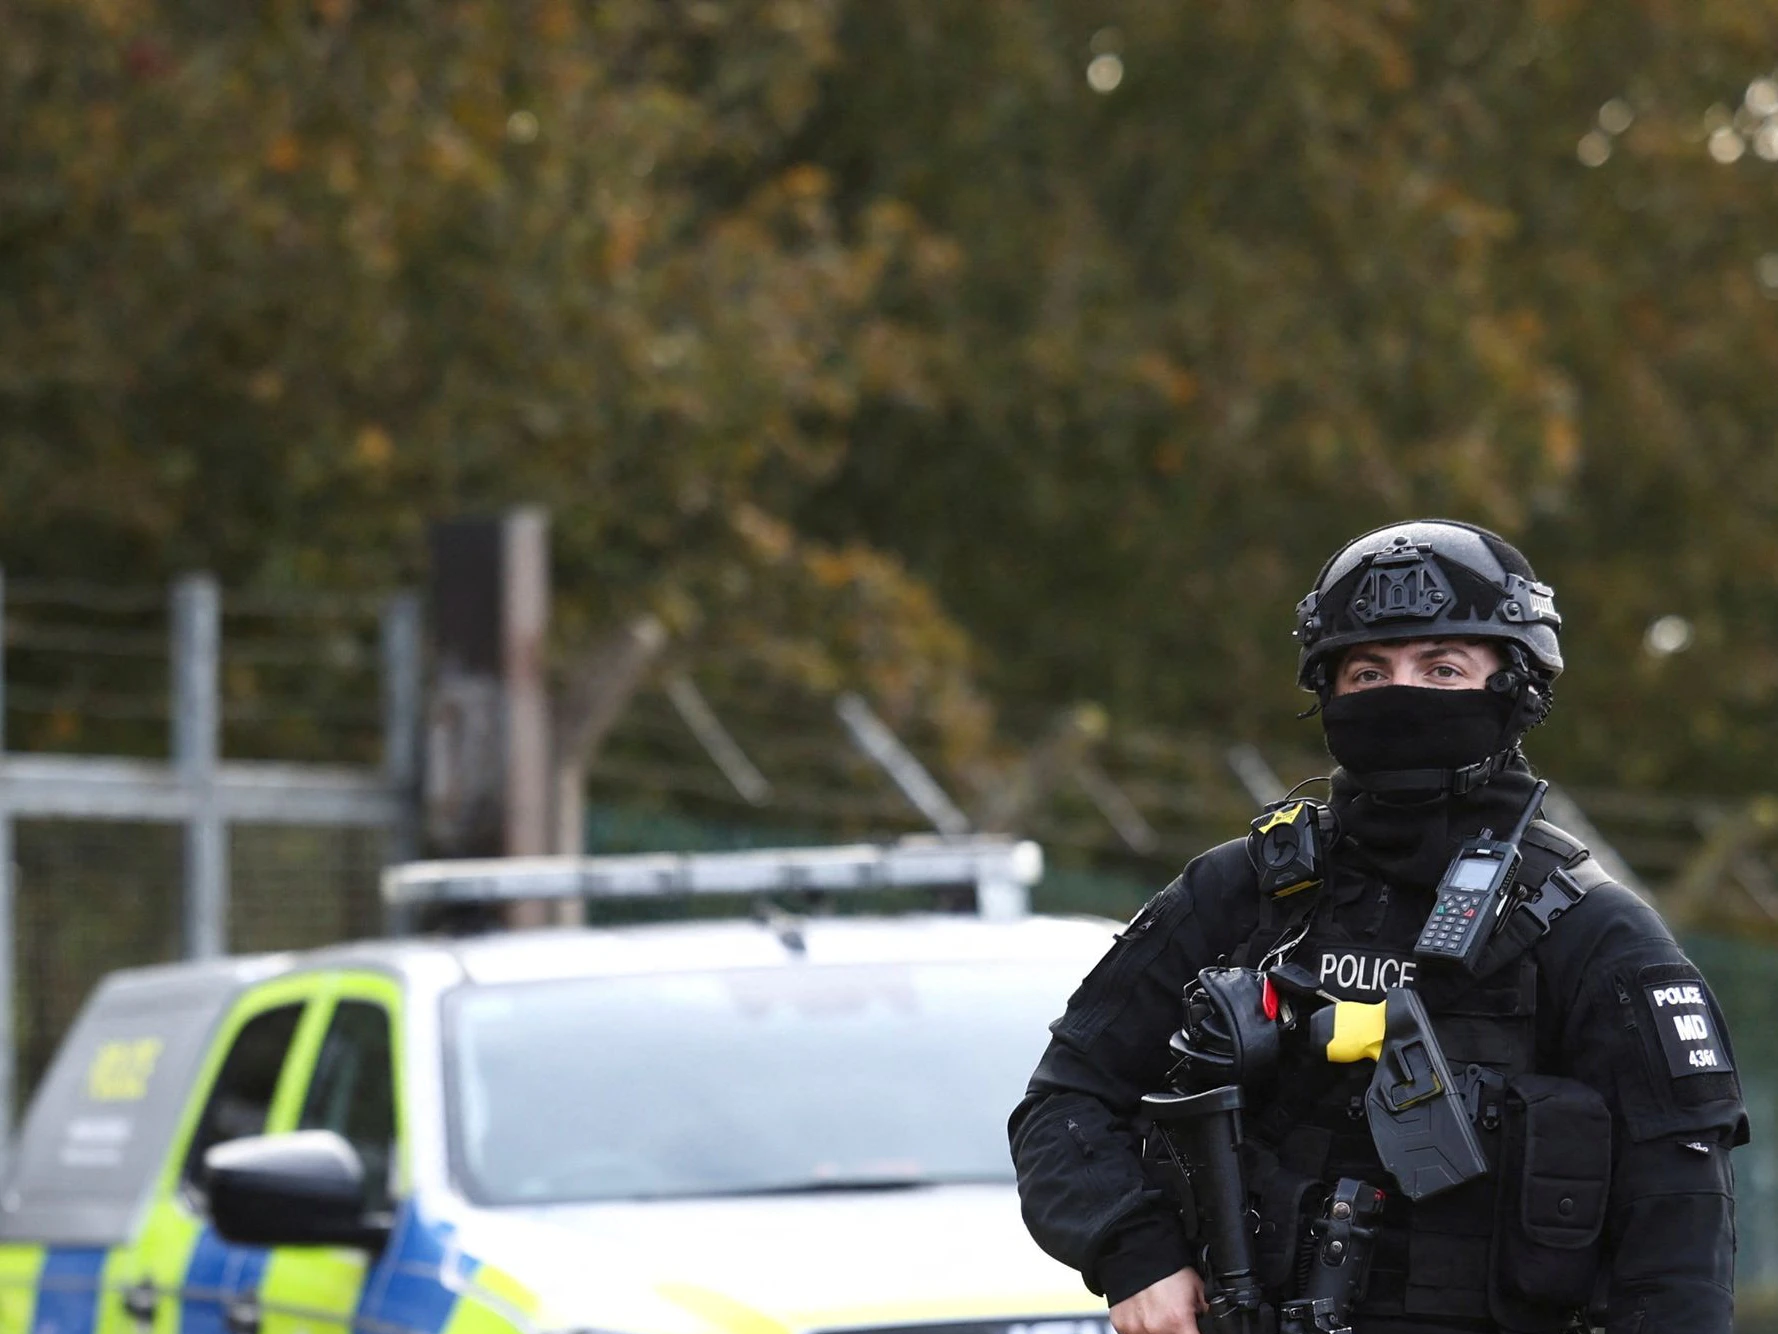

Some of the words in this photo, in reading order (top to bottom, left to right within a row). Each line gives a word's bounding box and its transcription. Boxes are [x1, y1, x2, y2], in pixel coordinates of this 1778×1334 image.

[1320, 953, 1417, 993] POLICE
[1653, 986, 1706, 1007] POLICE
[1673, 1014, 1708, 1041] MD
